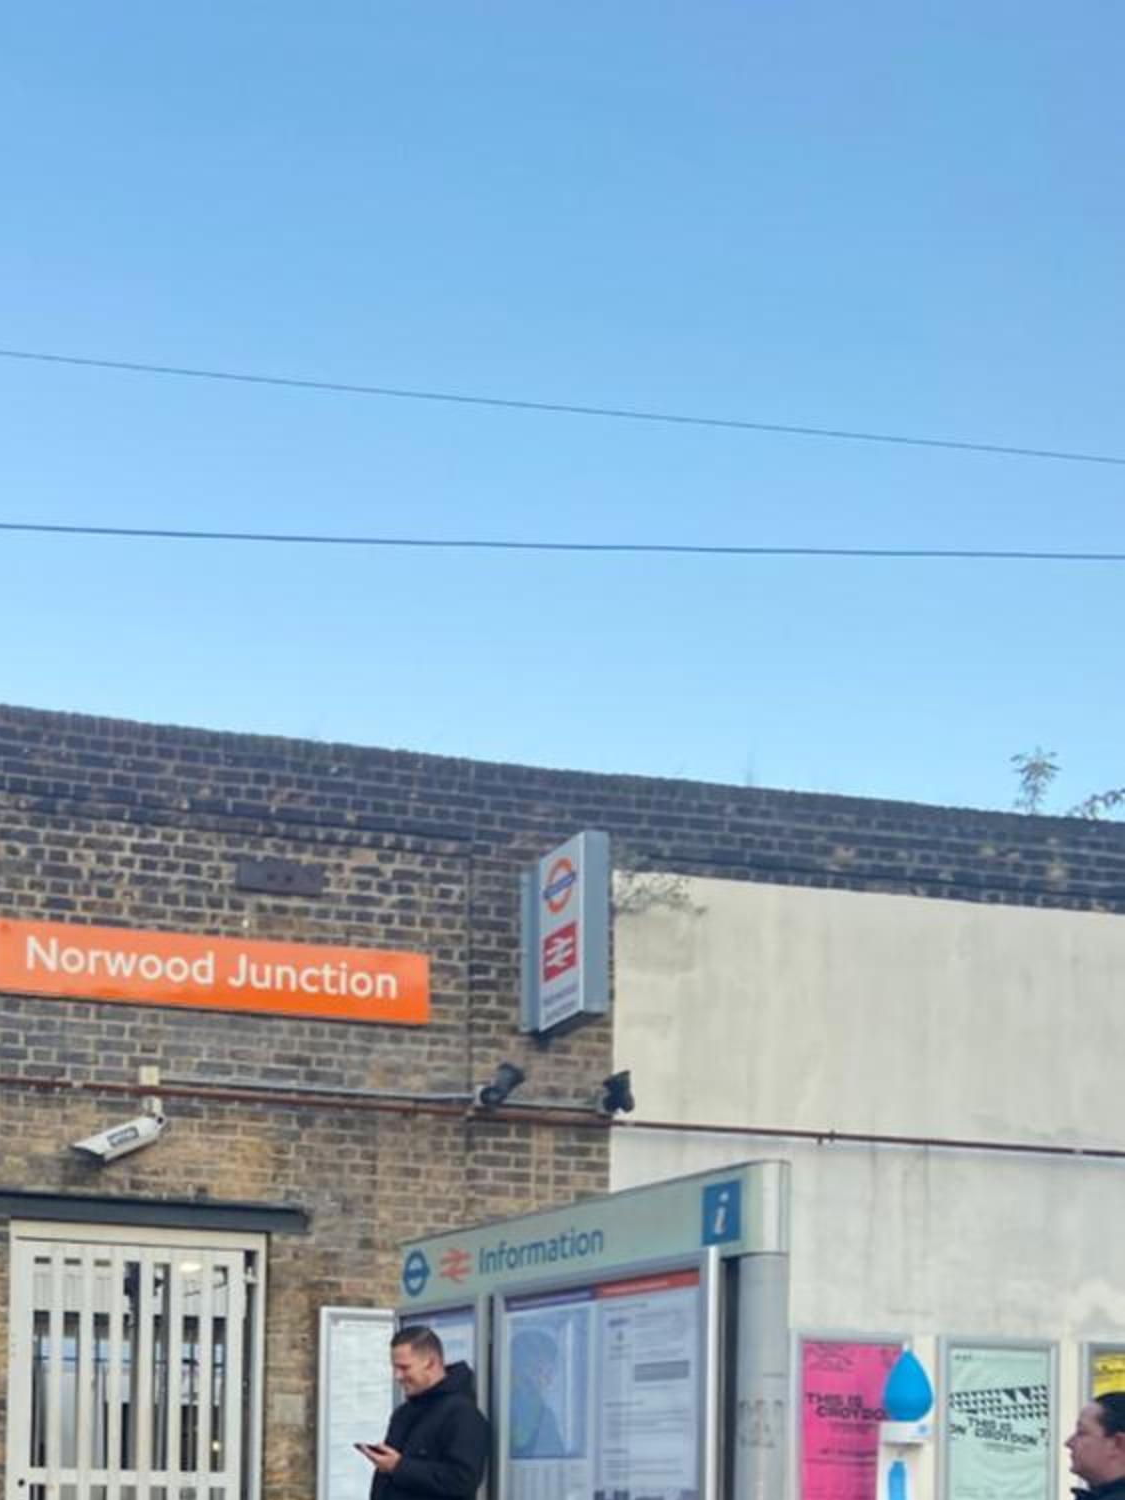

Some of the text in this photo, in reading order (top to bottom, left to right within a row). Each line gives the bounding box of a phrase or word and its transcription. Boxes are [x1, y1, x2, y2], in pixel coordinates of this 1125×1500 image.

[25, 936, 398, 999] Norwood Junction
[478, 1227, 604, 1275] Information
[806, 1392, 843, 1406] THIS
